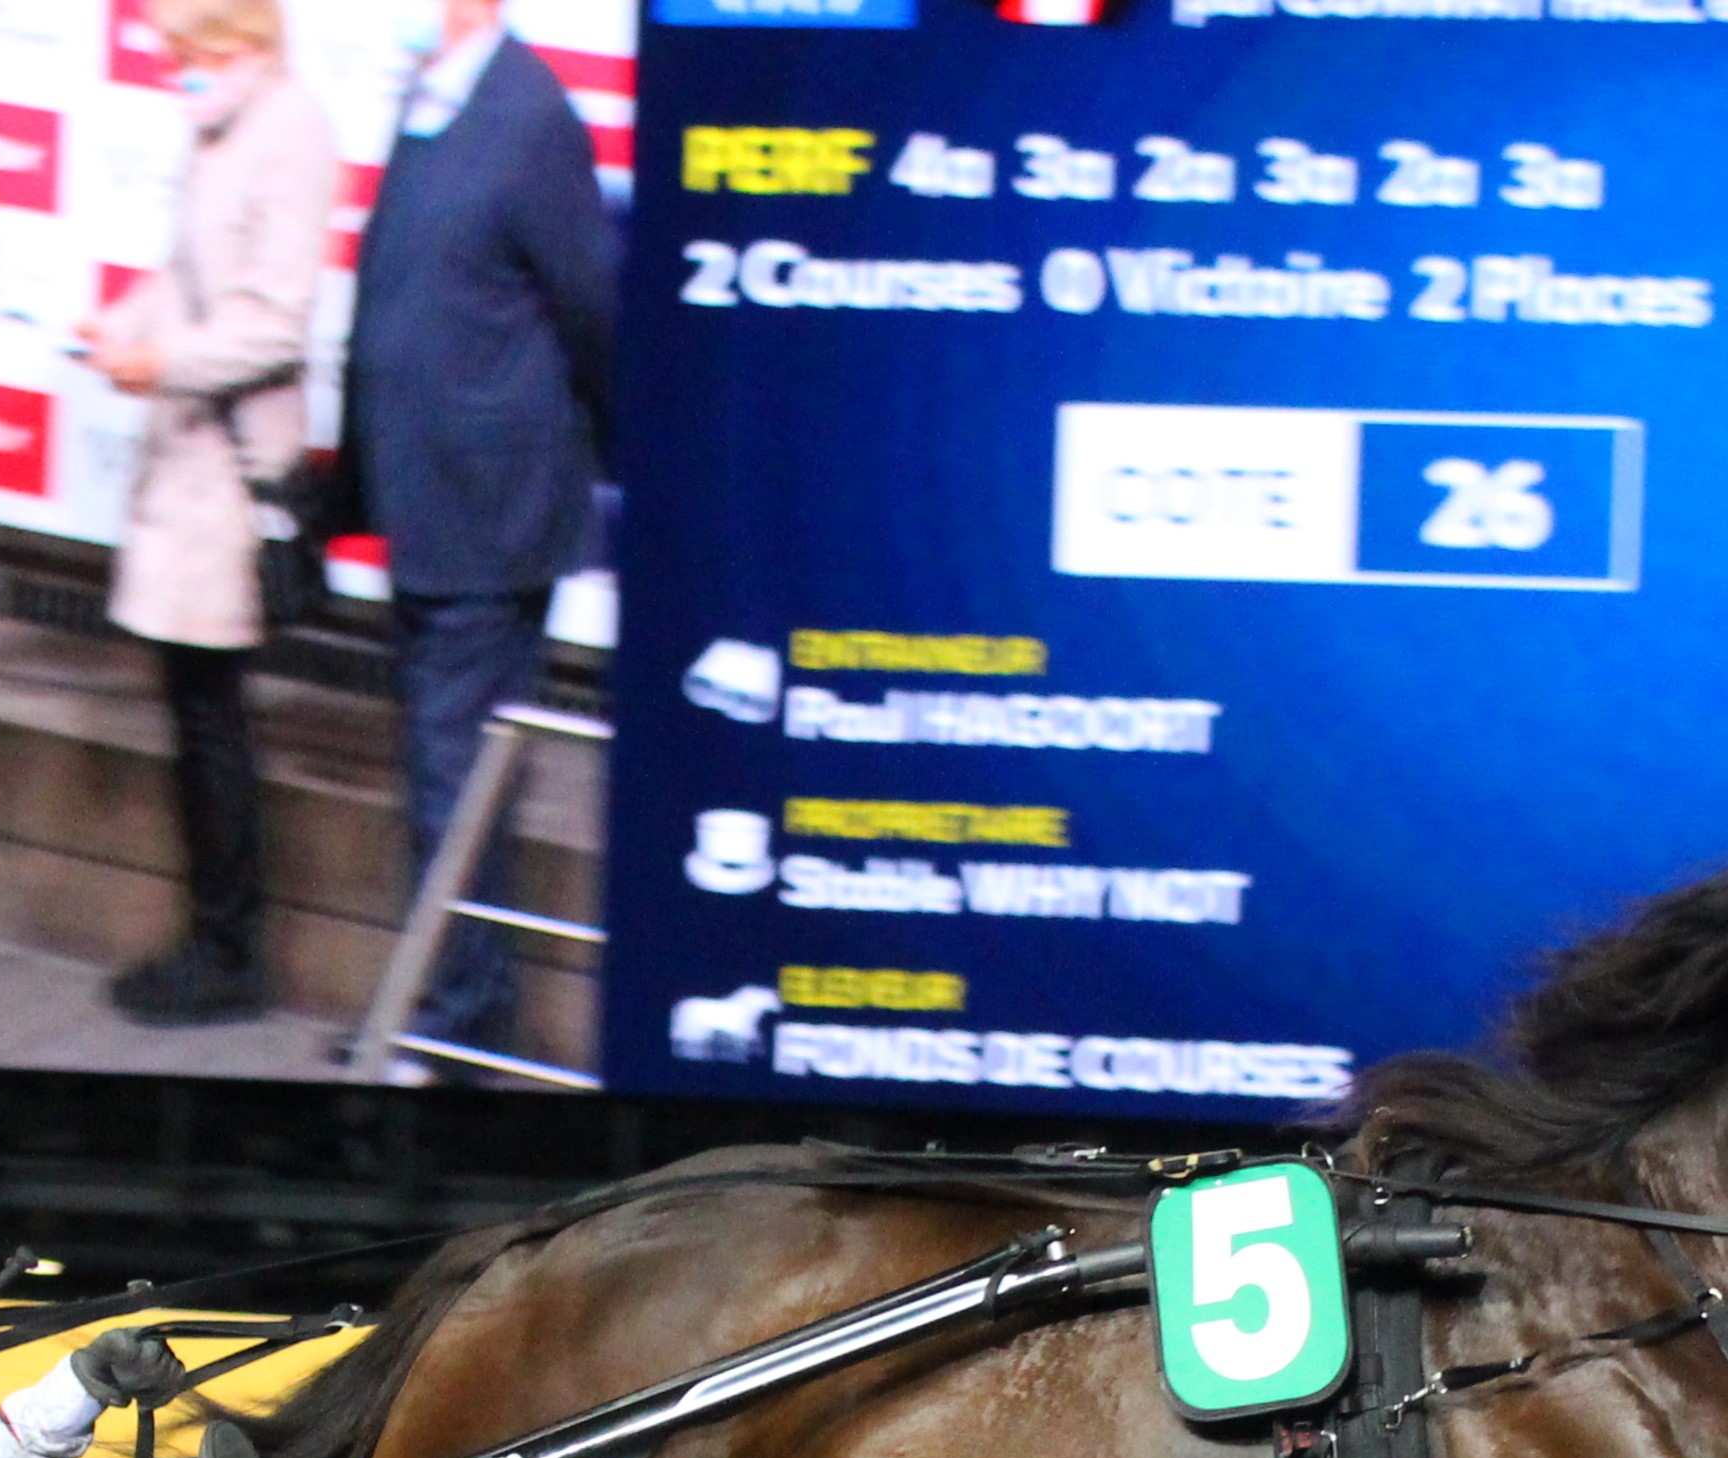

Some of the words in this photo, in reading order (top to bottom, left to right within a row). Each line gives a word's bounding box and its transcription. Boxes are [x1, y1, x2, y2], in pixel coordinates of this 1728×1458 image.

[682, 126, 876, 194] PERF
[680, 240, 738, 308] 2
[739, 240, 1023, 314] Courses
[1106, 248, 1391, 321] Victoire
[1409, 256, 1467, 322] 2
[1471, 254, 1714, 328] Places
[1097, 463, 1303, 531] COTE
[1419, 459, 1555, 550] 26
[783, 684, 903, 745] Paul
[906, 692, 1224, 755] HAGOORT
[777, 854, 964, 915] Stable
[960, 860, 1109, 921] WHY
[1110, 866, 1253, 926] NOT
[773, 1021, 977, 1085] FONDS
[980, 1031, 1071, 1089] DE
[1073, 1035, 1355, 1101] COURSES
[1191, 1176, 1312, 1382] 5
